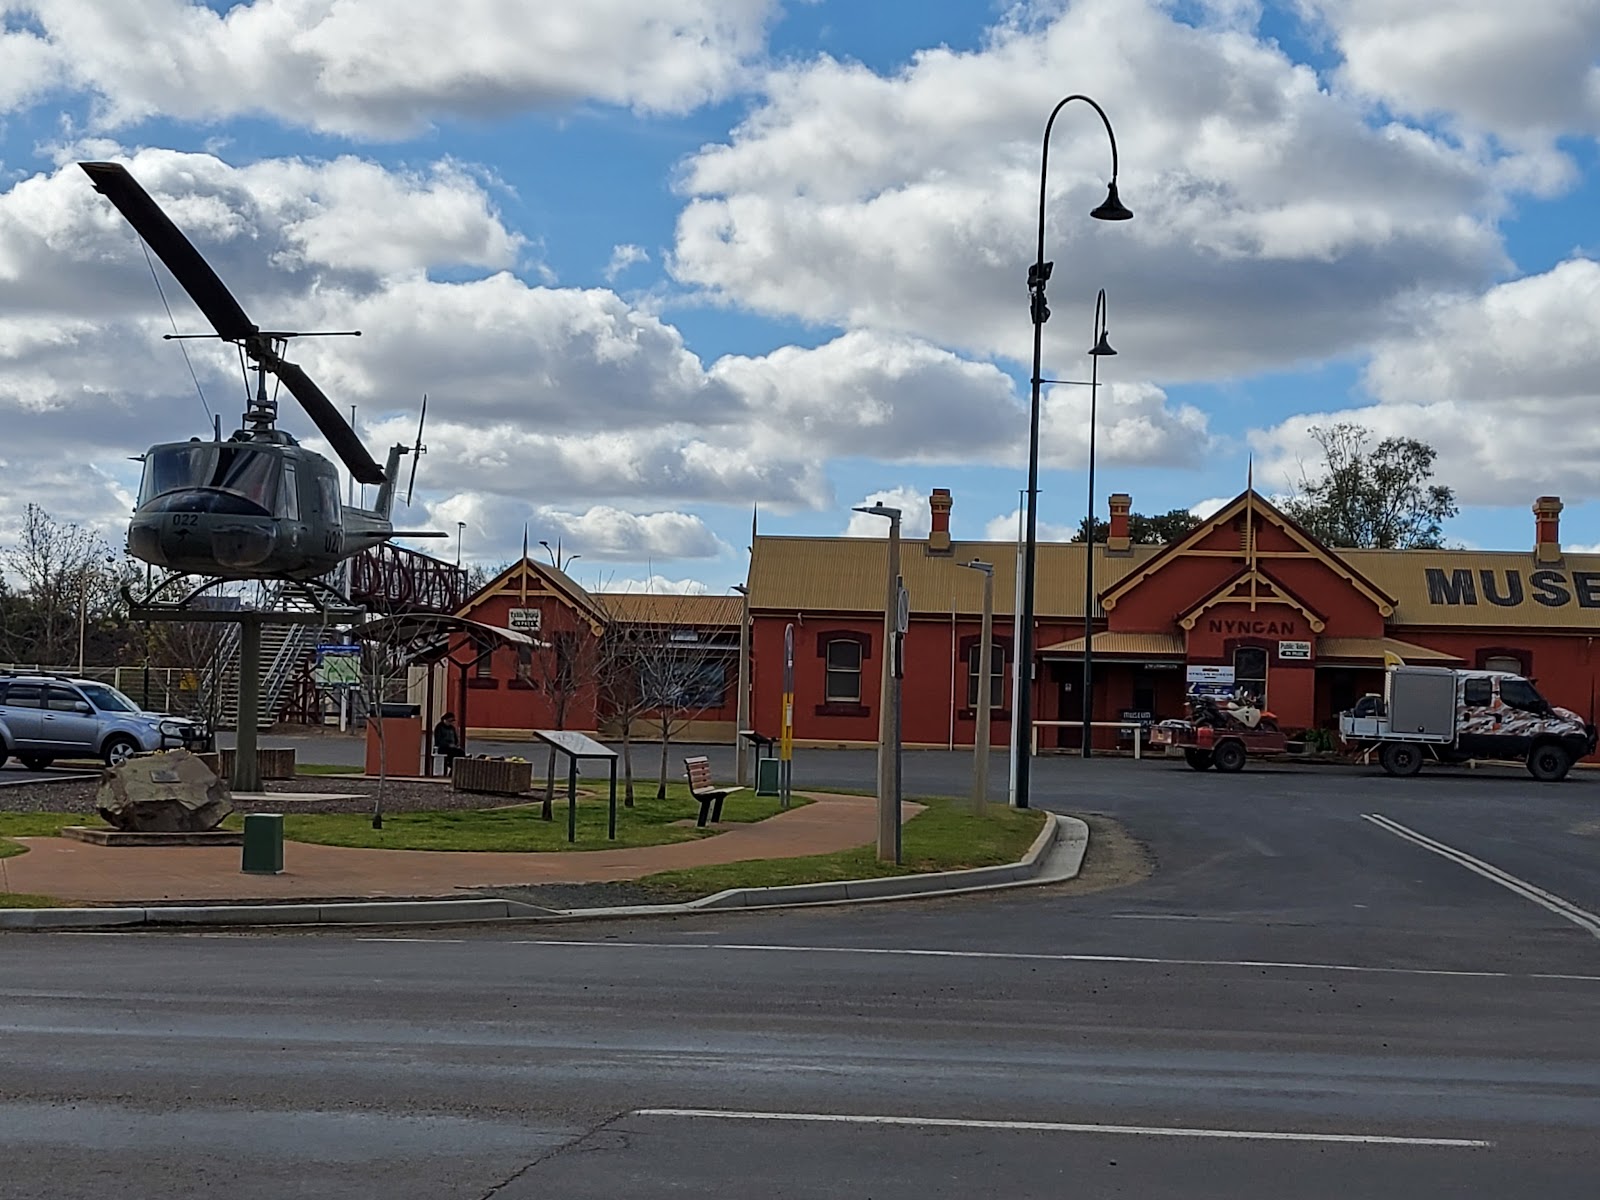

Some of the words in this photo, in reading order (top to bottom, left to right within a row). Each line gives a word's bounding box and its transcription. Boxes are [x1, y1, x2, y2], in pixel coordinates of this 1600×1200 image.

[173, 514, 198, 526] 022
[1425, 568, 1600, 608] MUSE
[1209, 620, 1295, 635] NYNGAN
